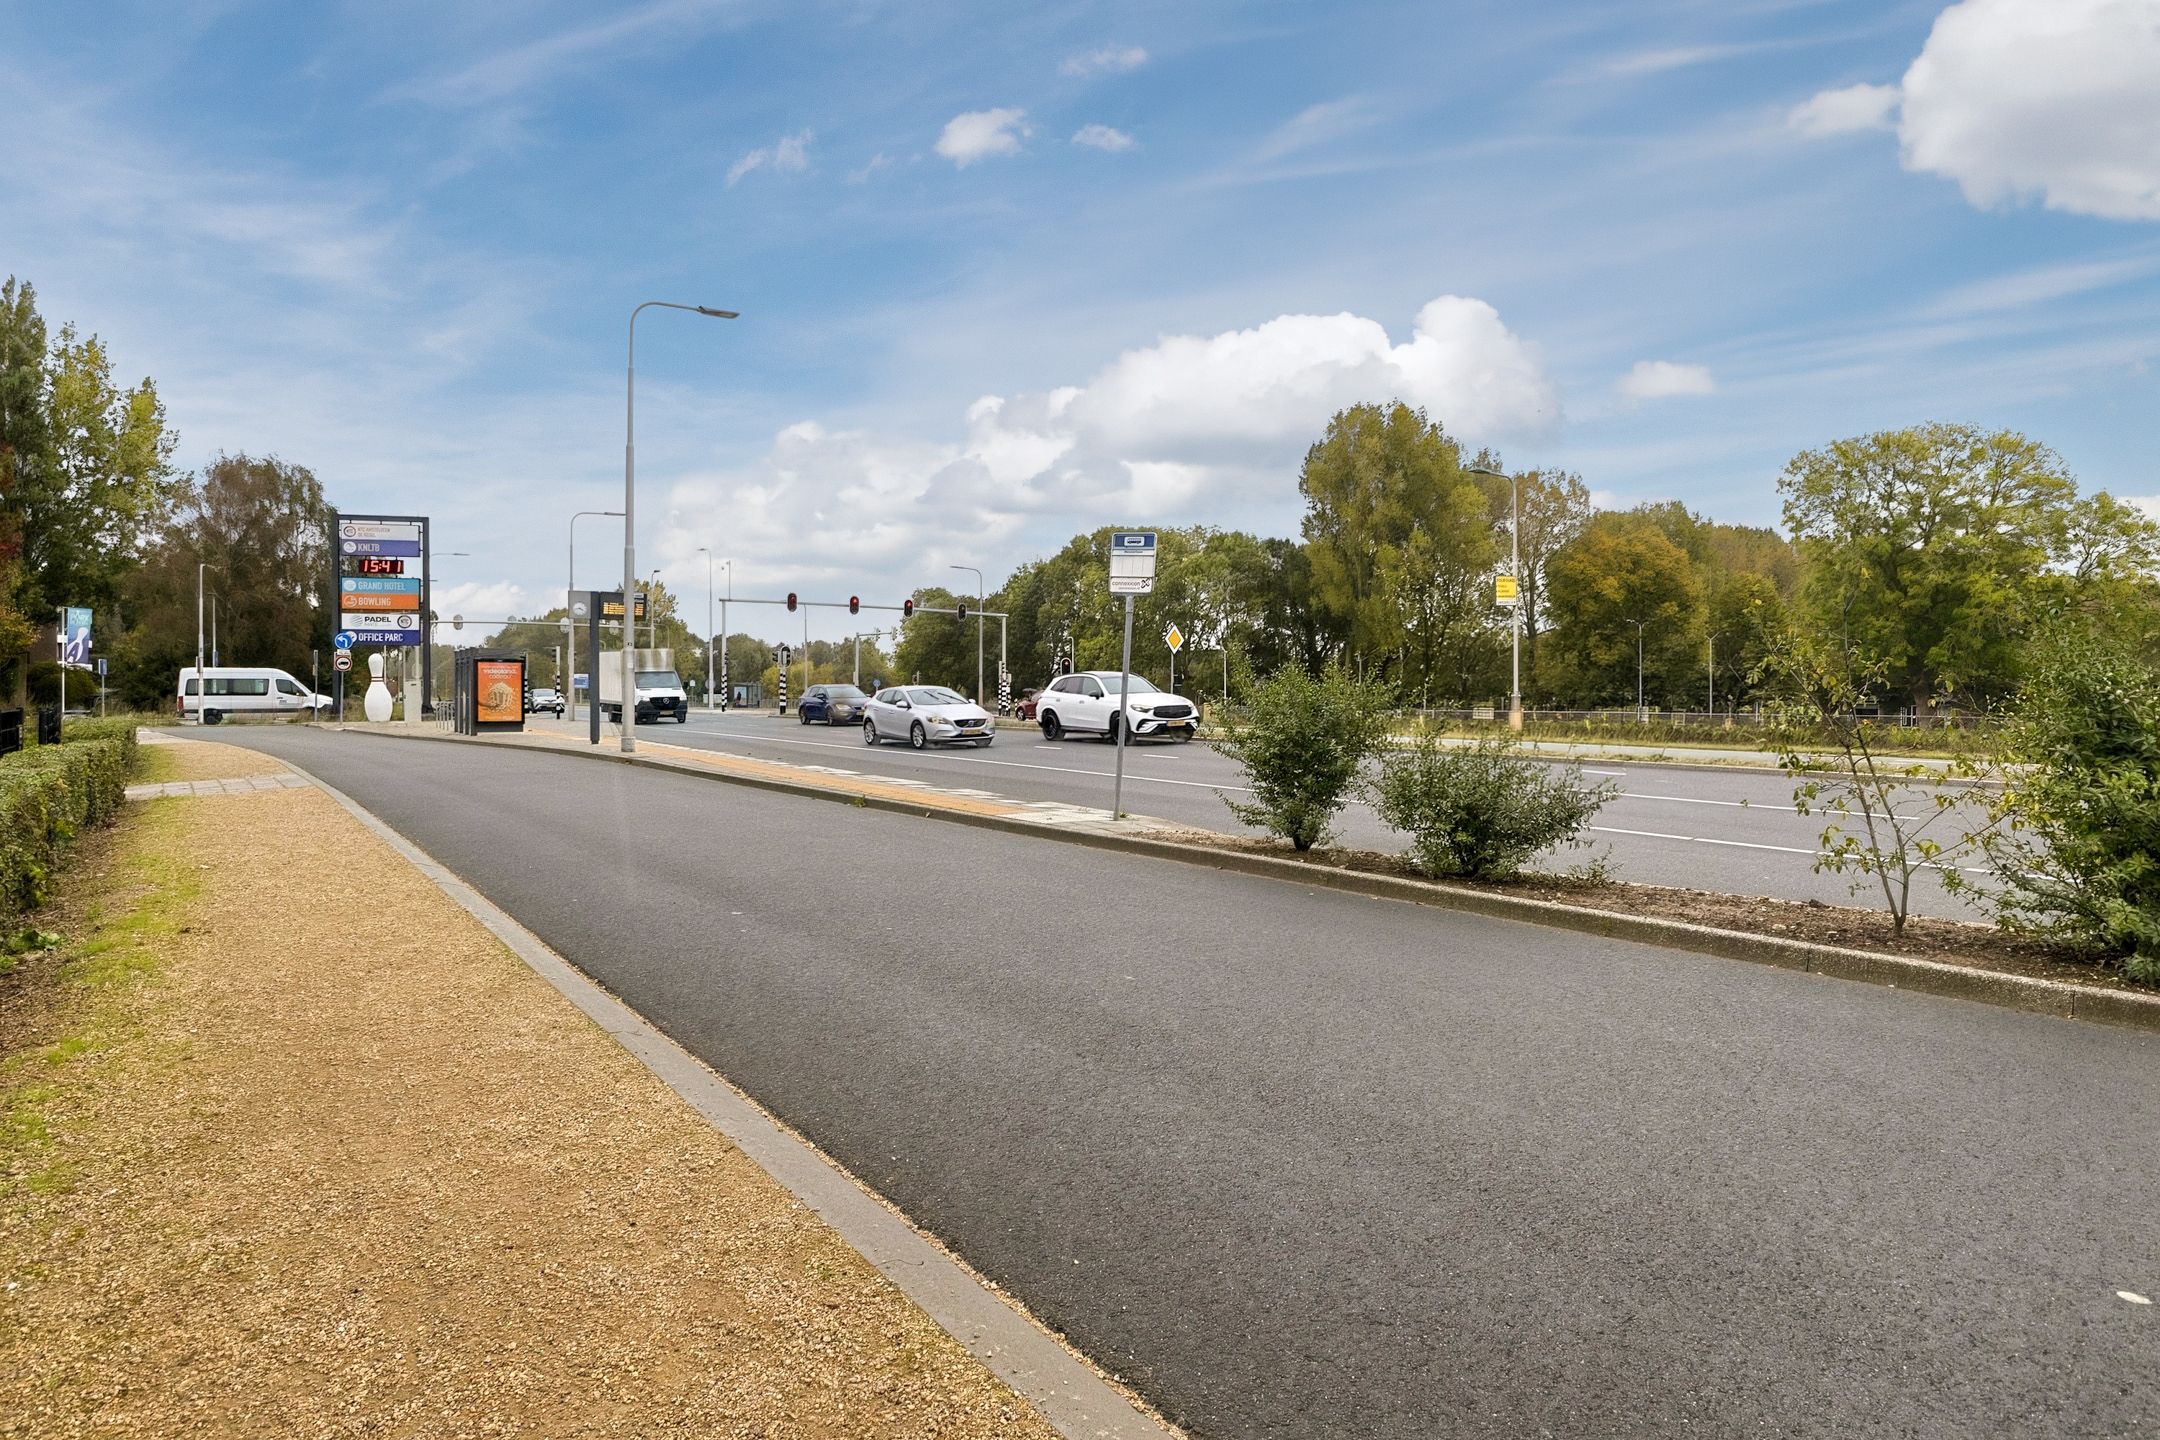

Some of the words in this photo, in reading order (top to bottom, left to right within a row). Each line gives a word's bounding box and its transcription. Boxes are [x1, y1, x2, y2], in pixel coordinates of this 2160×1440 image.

[357, 543, 381, 552] KNLTB
[364, 560, 401, 573] 15:41
[358, 581, 383, 590] GRAND
[384, 582, 405, 590] HOTEL
[358, 597, 392, 606] BOWLING
[358, 633, 384, 641] OFFICE
[385, 633, 404, 641] PARC
